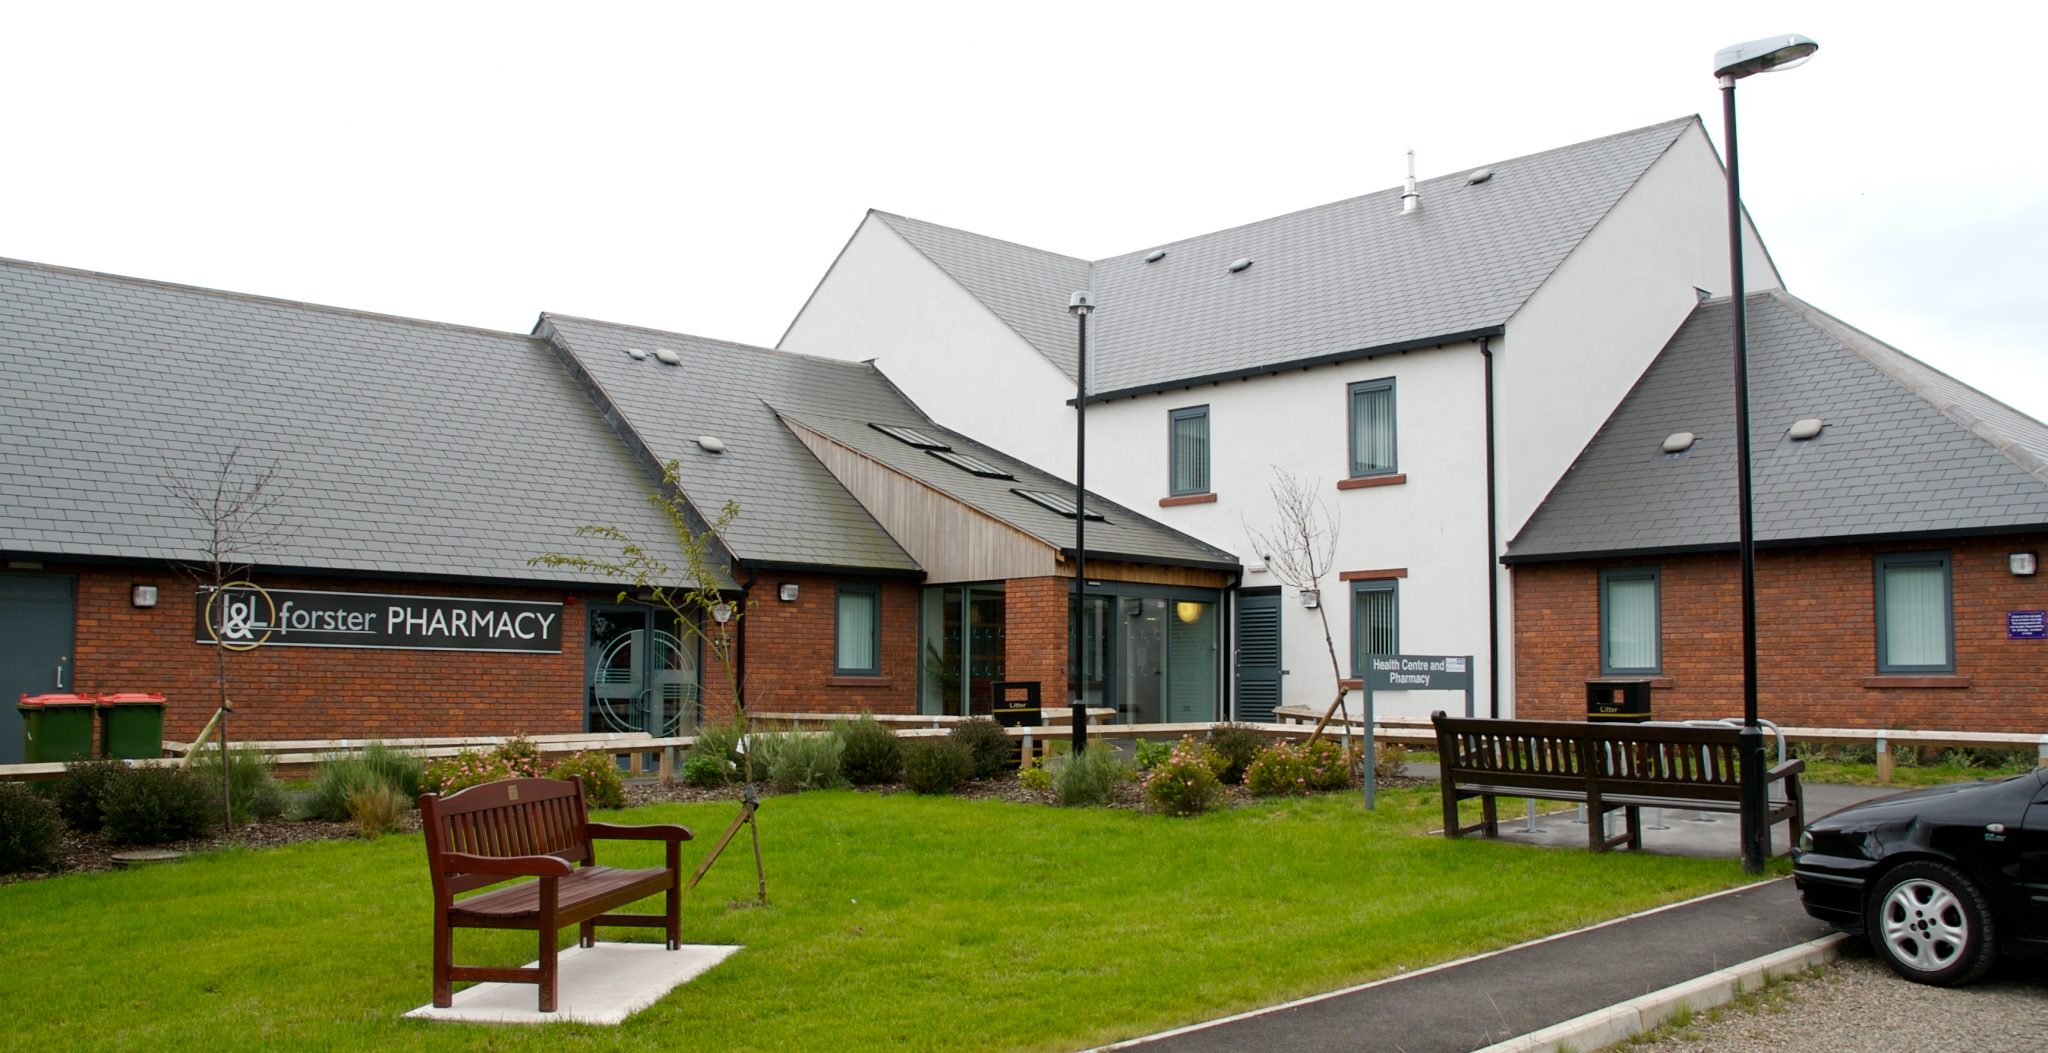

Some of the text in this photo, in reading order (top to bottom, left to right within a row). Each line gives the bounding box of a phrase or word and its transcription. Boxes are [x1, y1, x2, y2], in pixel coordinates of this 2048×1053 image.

[279, 601, 376, 635] forster
[387, 606, 555, 640] PHARMACY
[1373, 658, 1399, 671] Health
[1402, 659, 1428, 671] Centre
[1430, 660, 1445, 671] and
[1390, 673, 1430, 686] Pharmacy
